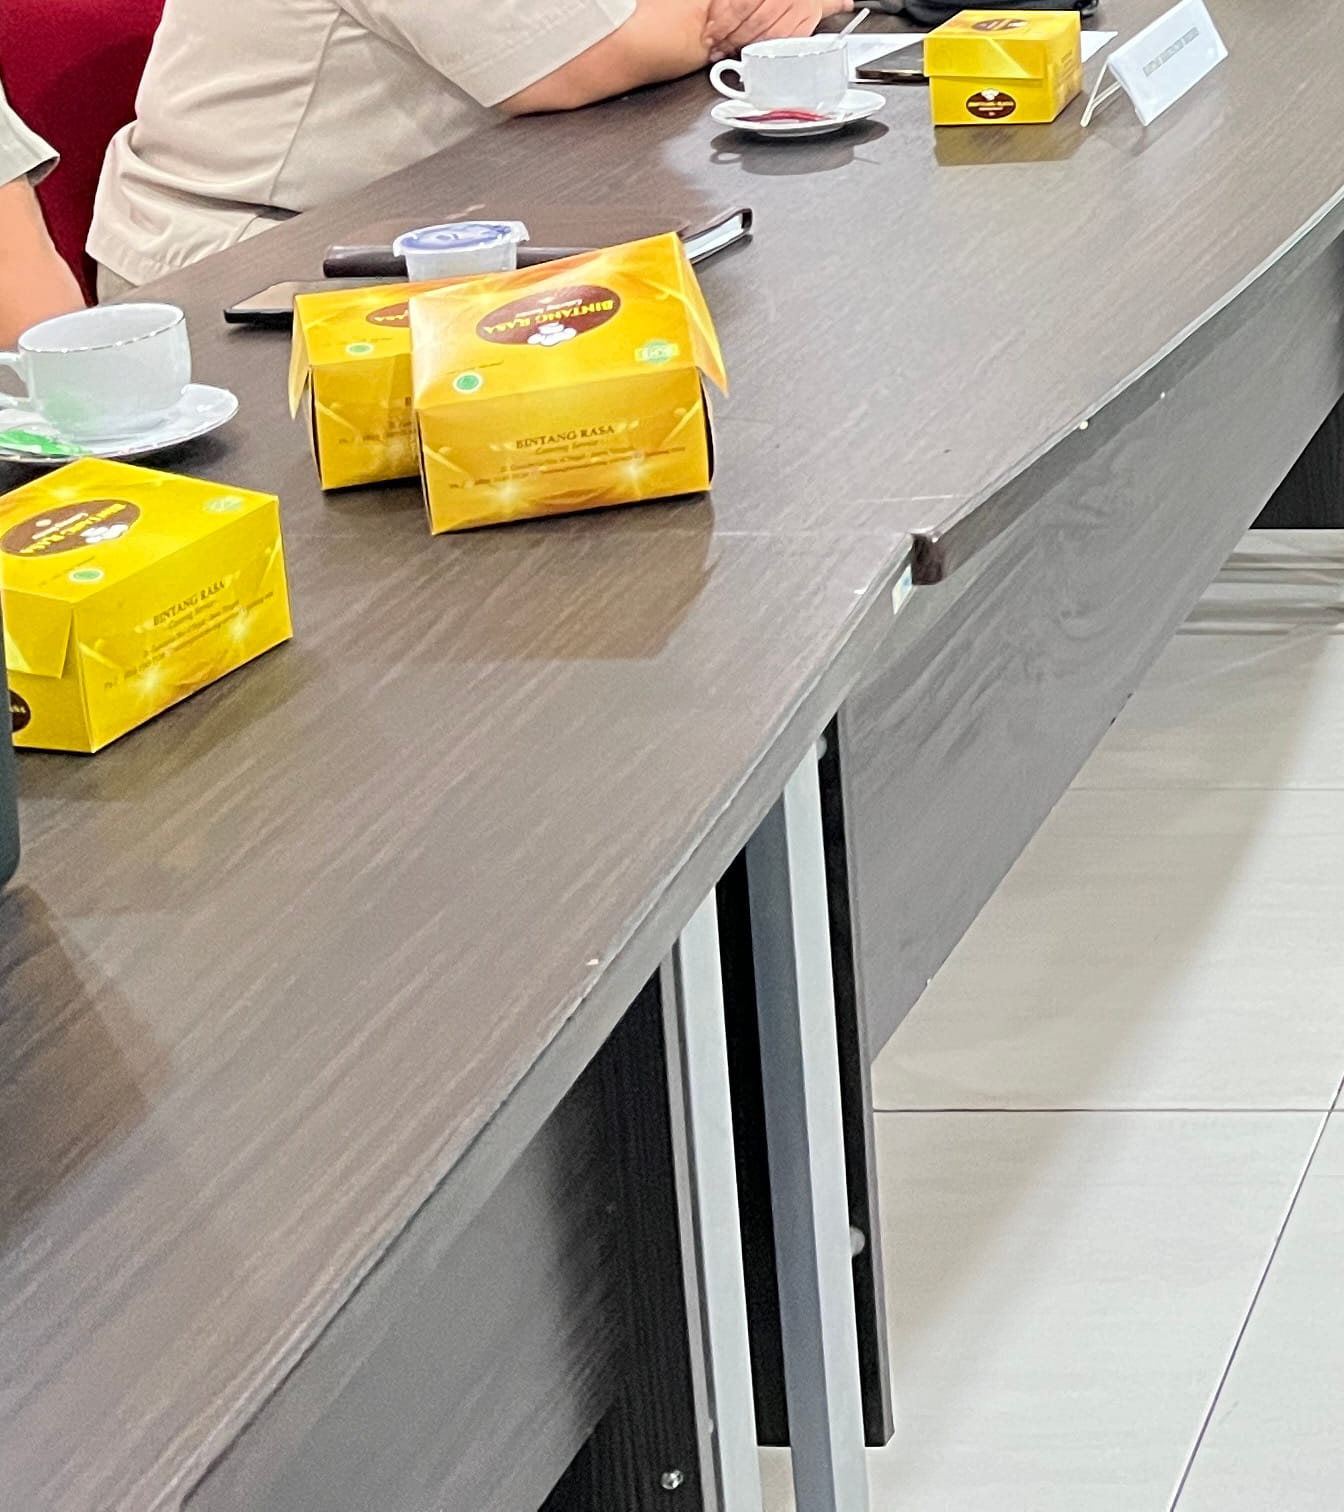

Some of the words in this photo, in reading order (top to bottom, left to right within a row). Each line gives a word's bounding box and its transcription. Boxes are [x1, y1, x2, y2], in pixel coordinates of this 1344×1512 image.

[535, 300, 614, 322] BINTANG
[483, 318, 531, 334] RASA
[515, 431, 577, 449] BINTANG
[580, 425, 615, 438] RASA
[153, 594, 198, 626] BINTANG
